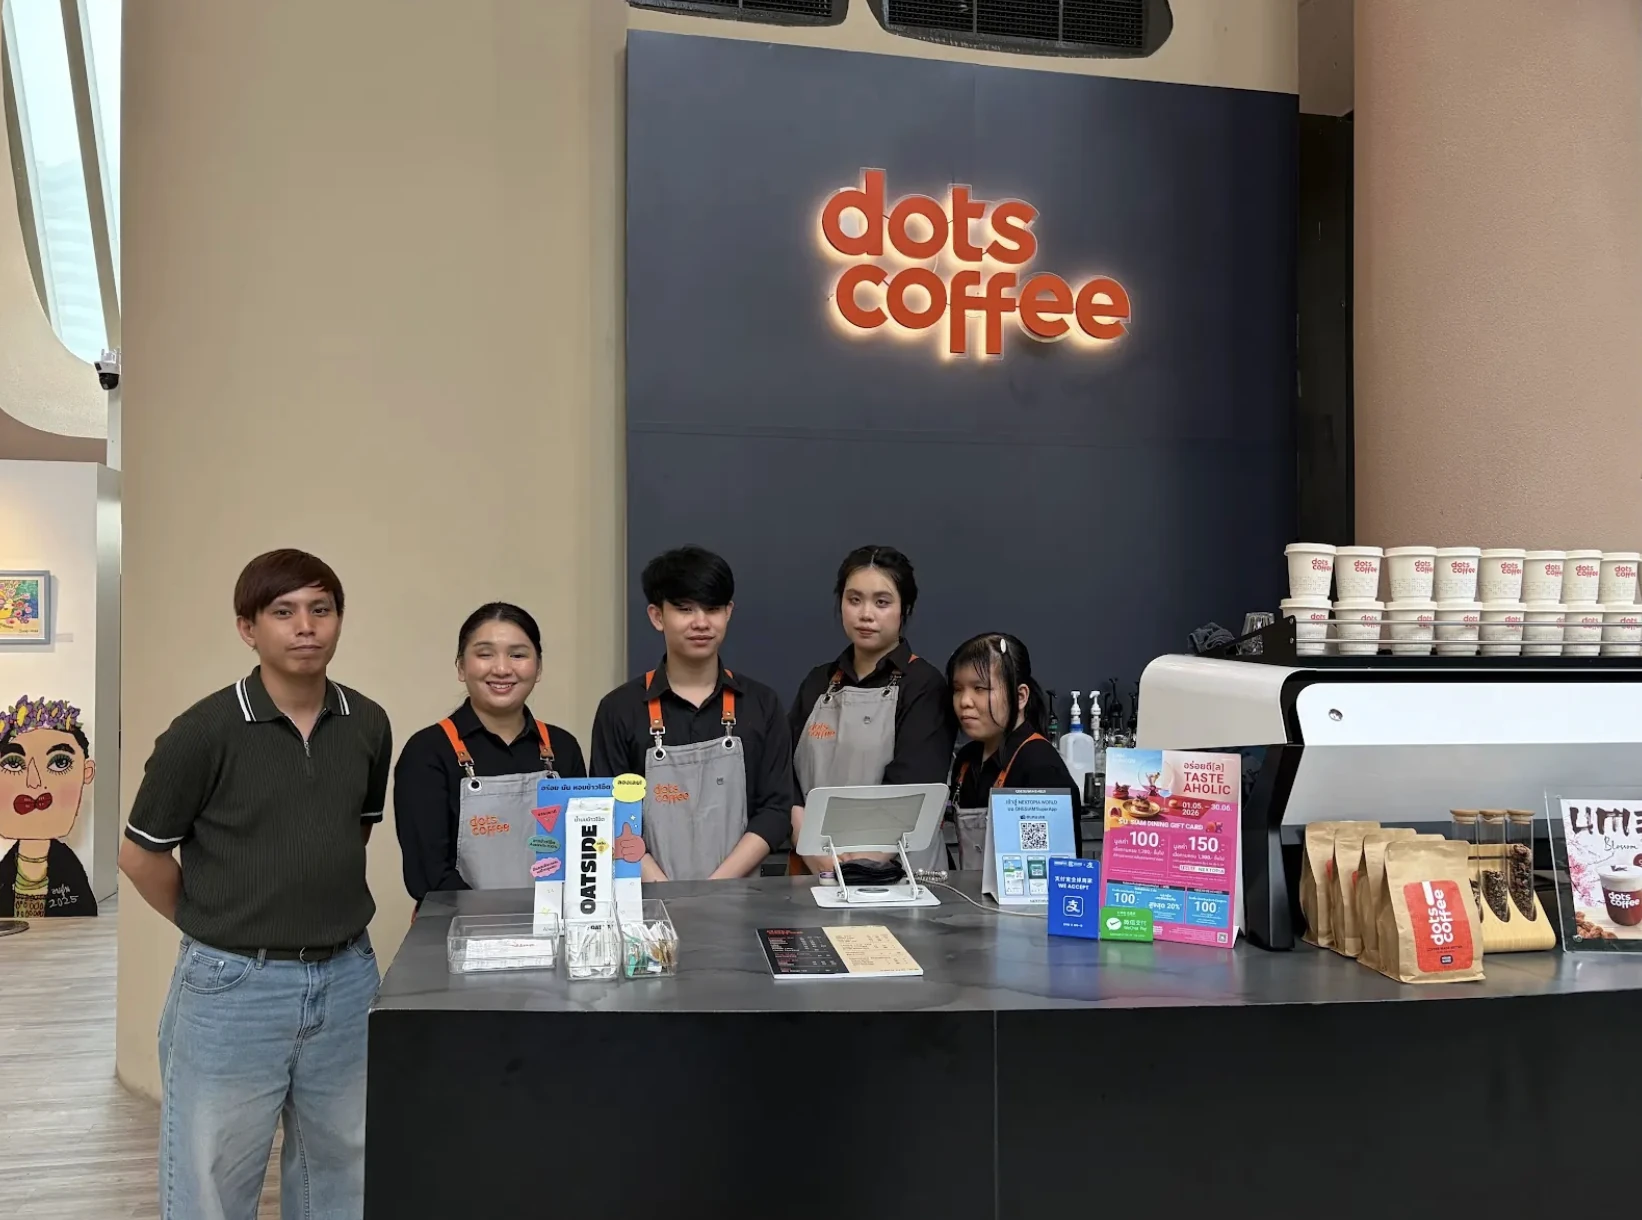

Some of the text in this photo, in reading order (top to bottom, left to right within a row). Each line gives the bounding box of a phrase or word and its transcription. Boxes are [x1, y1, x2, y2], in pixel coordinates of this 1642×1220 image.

[821, 169, 1039, 265] dots
[835, 263, 1131, 355] coffee
[1312, 558, 1328, 566] dots
[1354, 560, 1372, 568] dots
[1355, 565, 1377, 574] coffee
[1452, 567, 1475, 575] coffee
[1184, 772, 1224, 784] TASTE
[654, 784, 678, 794] dots
[1183, 783, 1231, 795] AHOLIC
[656, 792, 689, 804] coffee
[470, 815, 497, 827] dots
[472, 824, 509, 837] coffee
[1604, 836, 1638, 851] Blossom
[580, 824, 598, 915] OATSIDE
[49, 895, 79, 909] 2025
[1608, 891, 1631, 901] dots
[1610, 898, 1640, 909] coffee
[1434, 889, 1454, 943] coffee
[1428, 907, 1445, 945] dots
